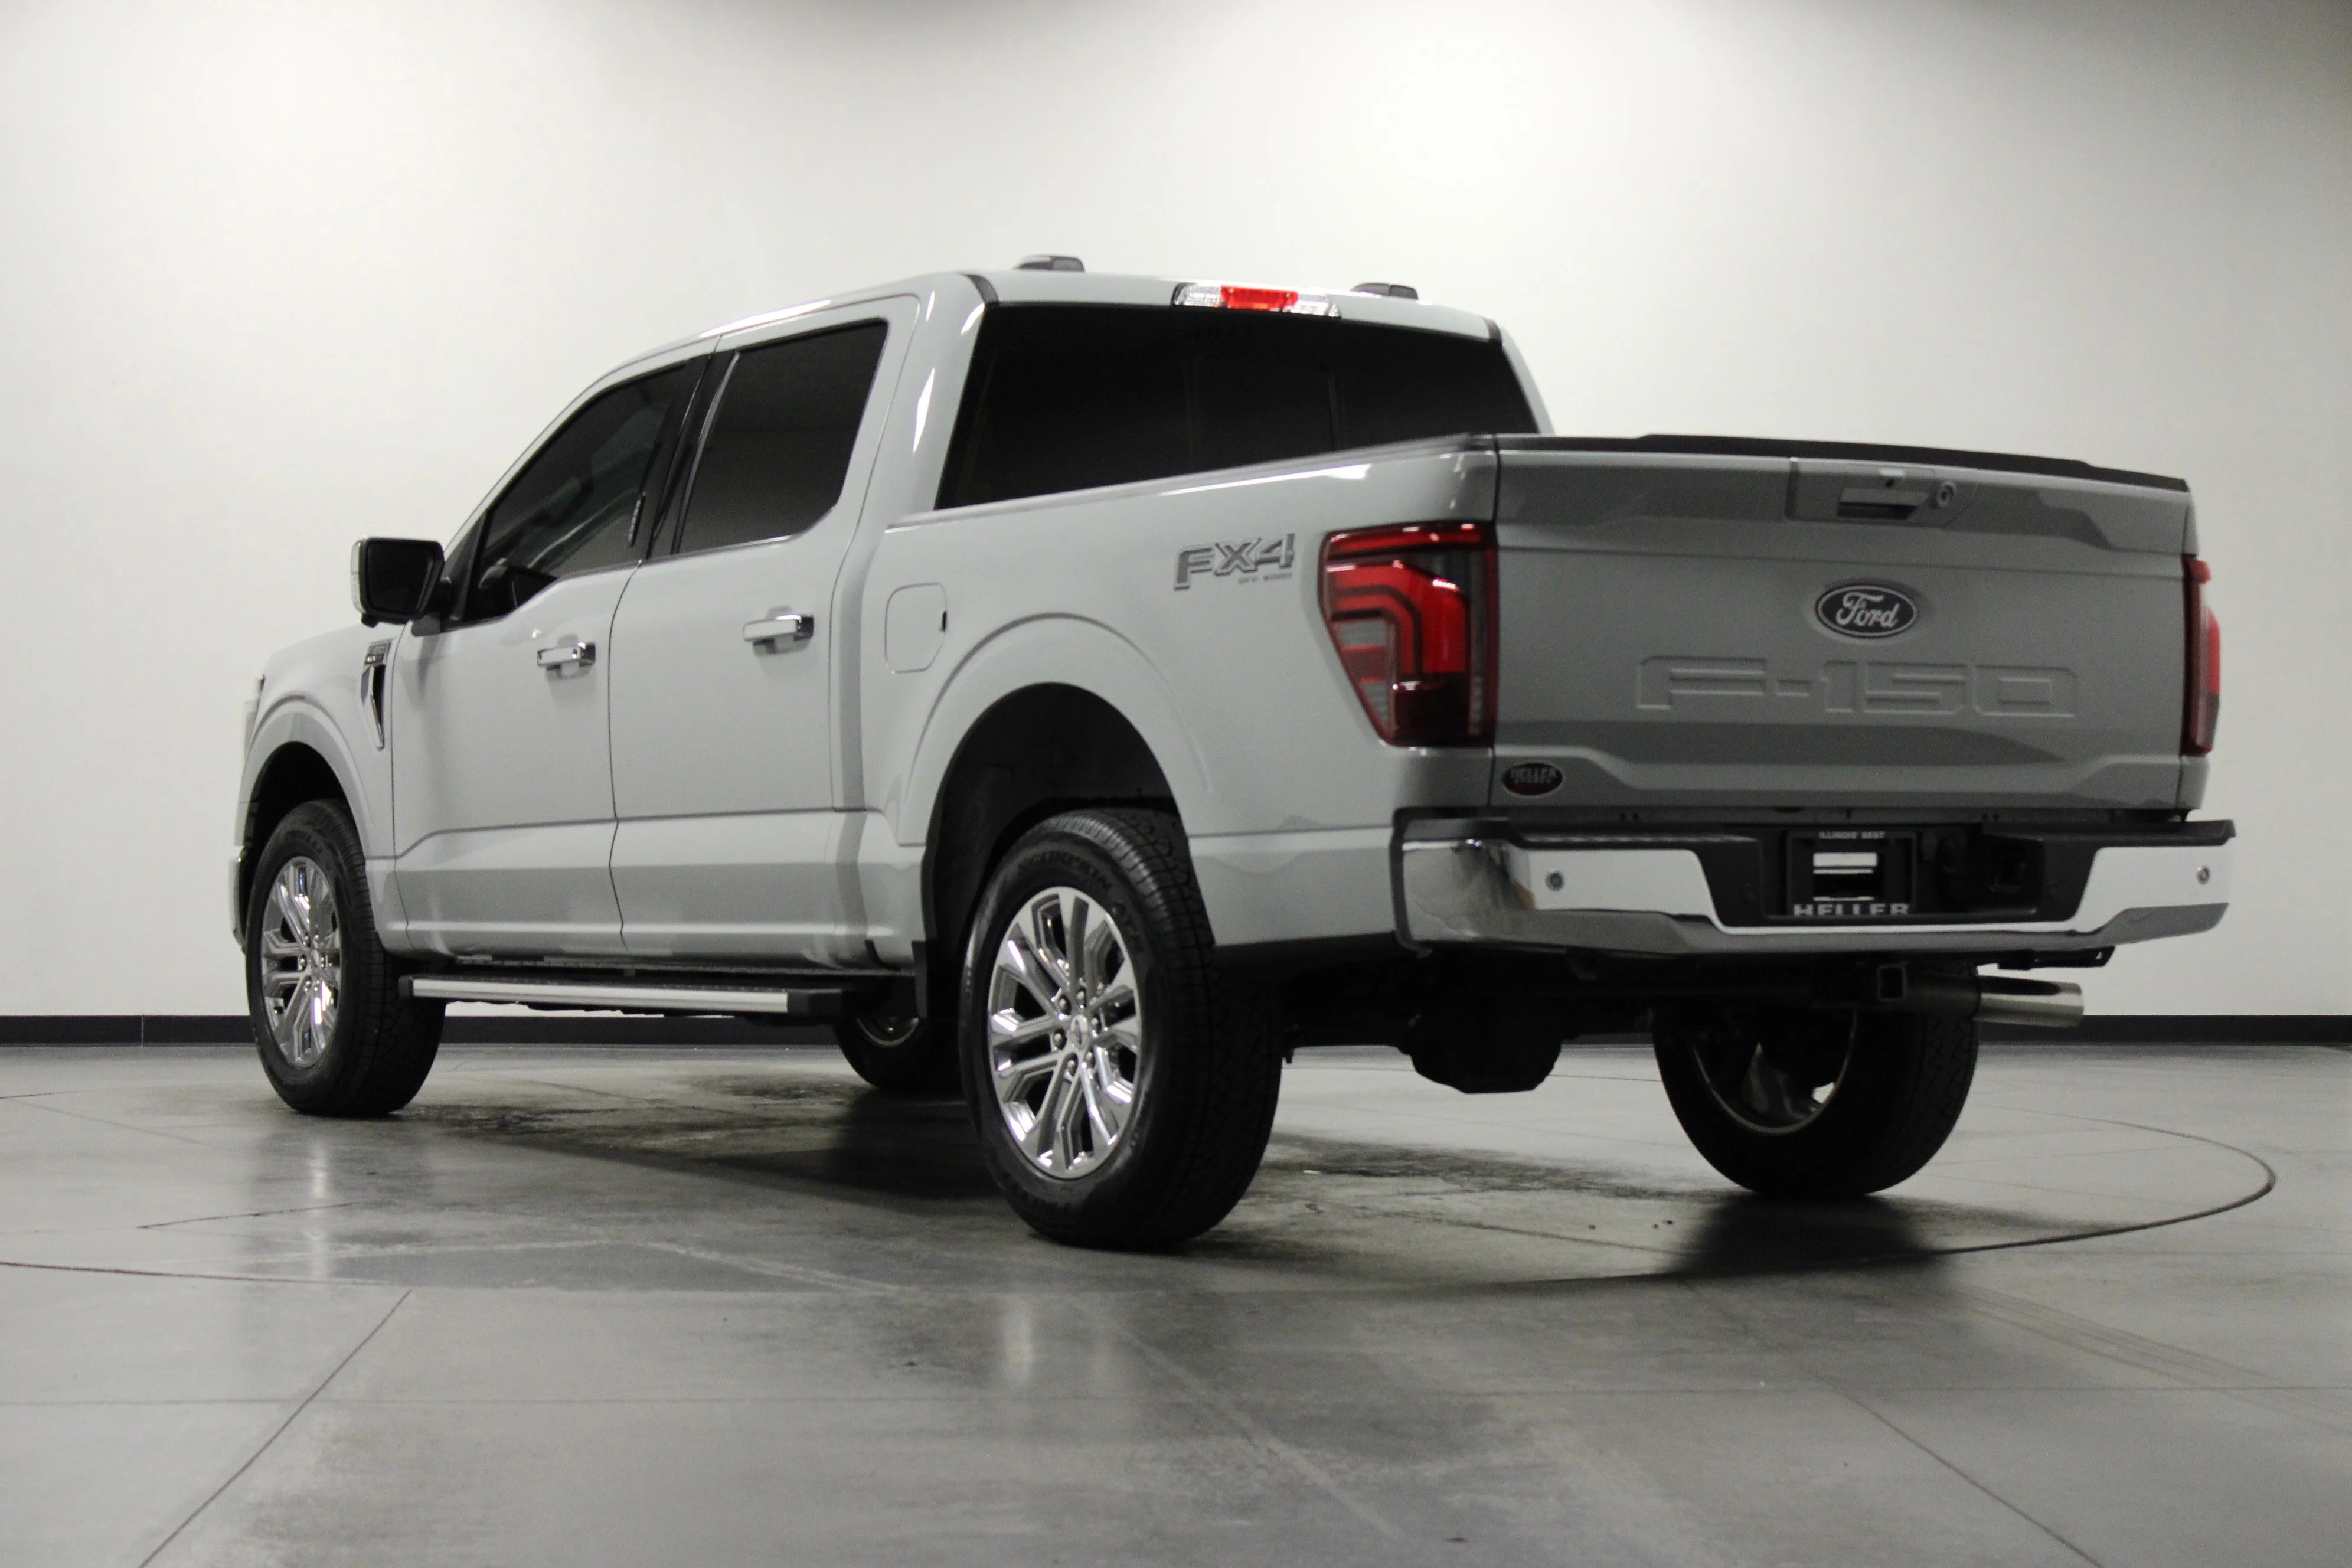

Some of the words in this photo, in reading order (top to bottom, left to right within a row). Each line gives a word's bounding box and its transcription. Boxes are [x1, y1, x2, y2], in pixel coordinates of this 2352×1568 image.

[1174, 533, 1295, 590] FX4
[1835, 592, 1901, 628] Ford
[1637, 655, 2076, 718] F-150
[1793, 903, 1910, 916] HELLER
